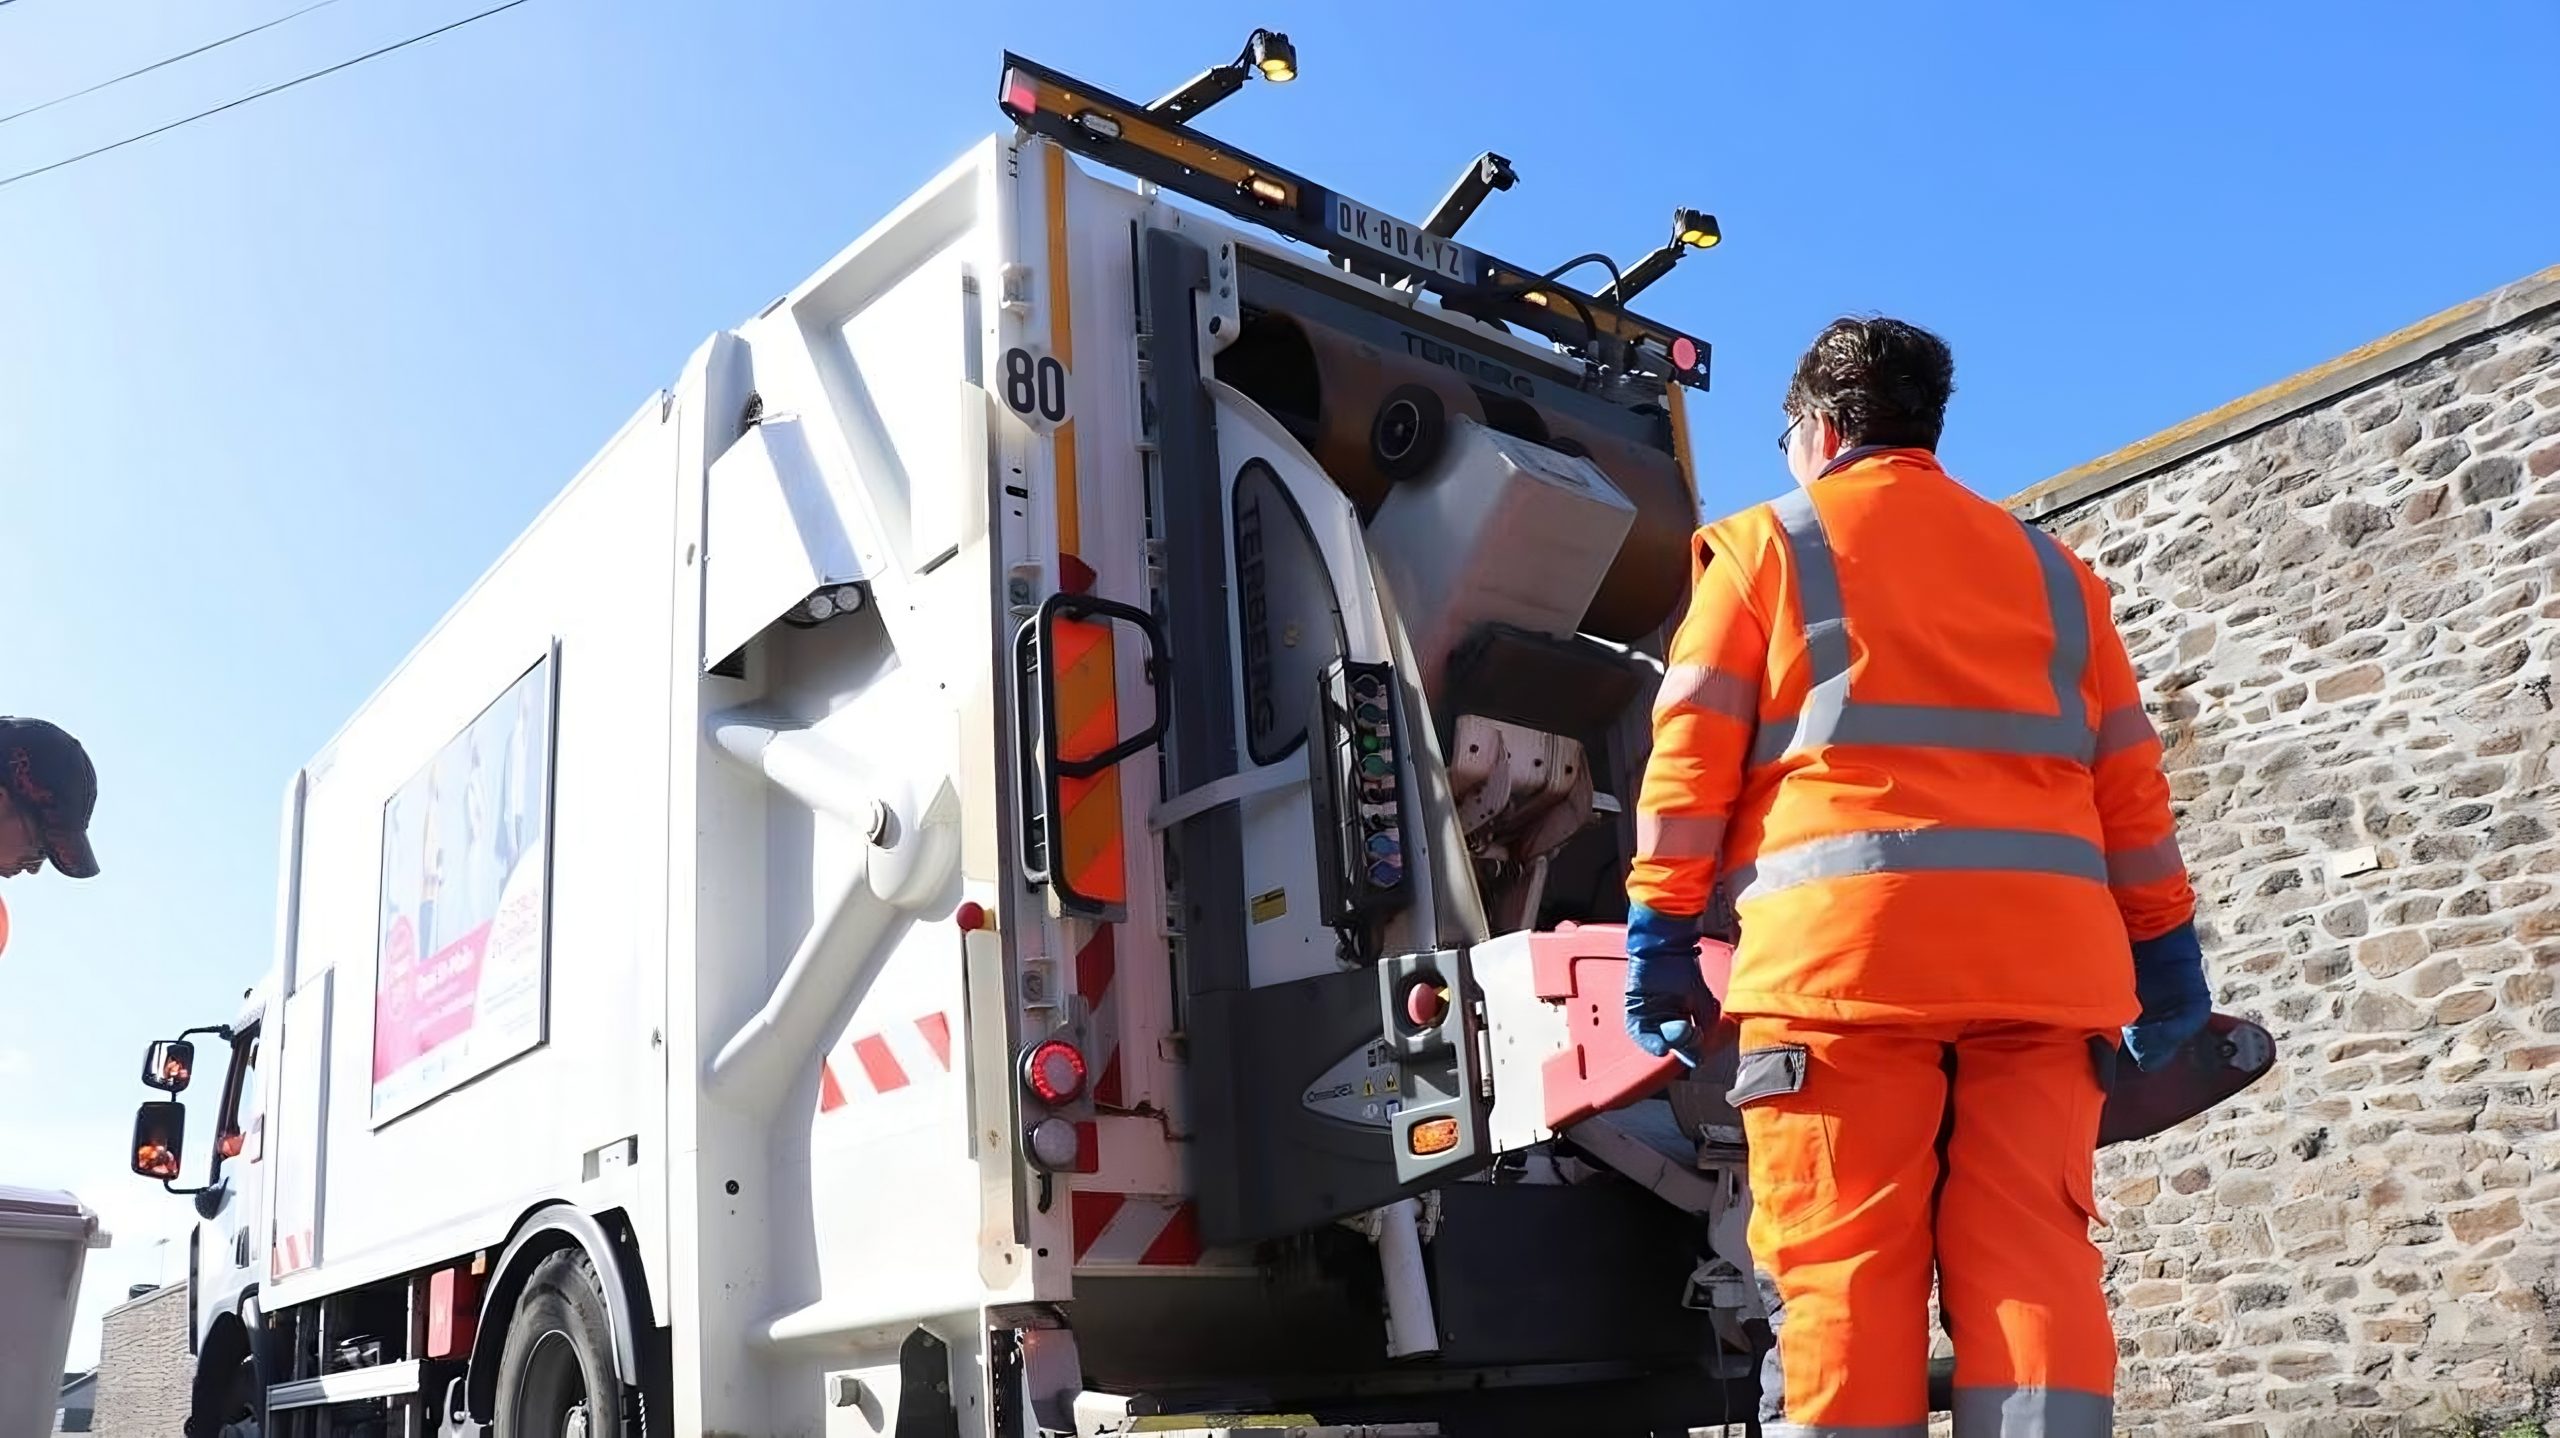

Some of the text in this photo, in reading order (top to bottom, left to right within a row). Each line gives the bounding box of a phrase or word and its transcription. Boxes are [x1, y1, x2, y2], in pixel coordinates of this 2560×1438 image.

[1006, 347, 1066, 422] 80
[1400, 330, 1535, 399] TERBERG
[1239, 496, 1275, 738] TERBERG
